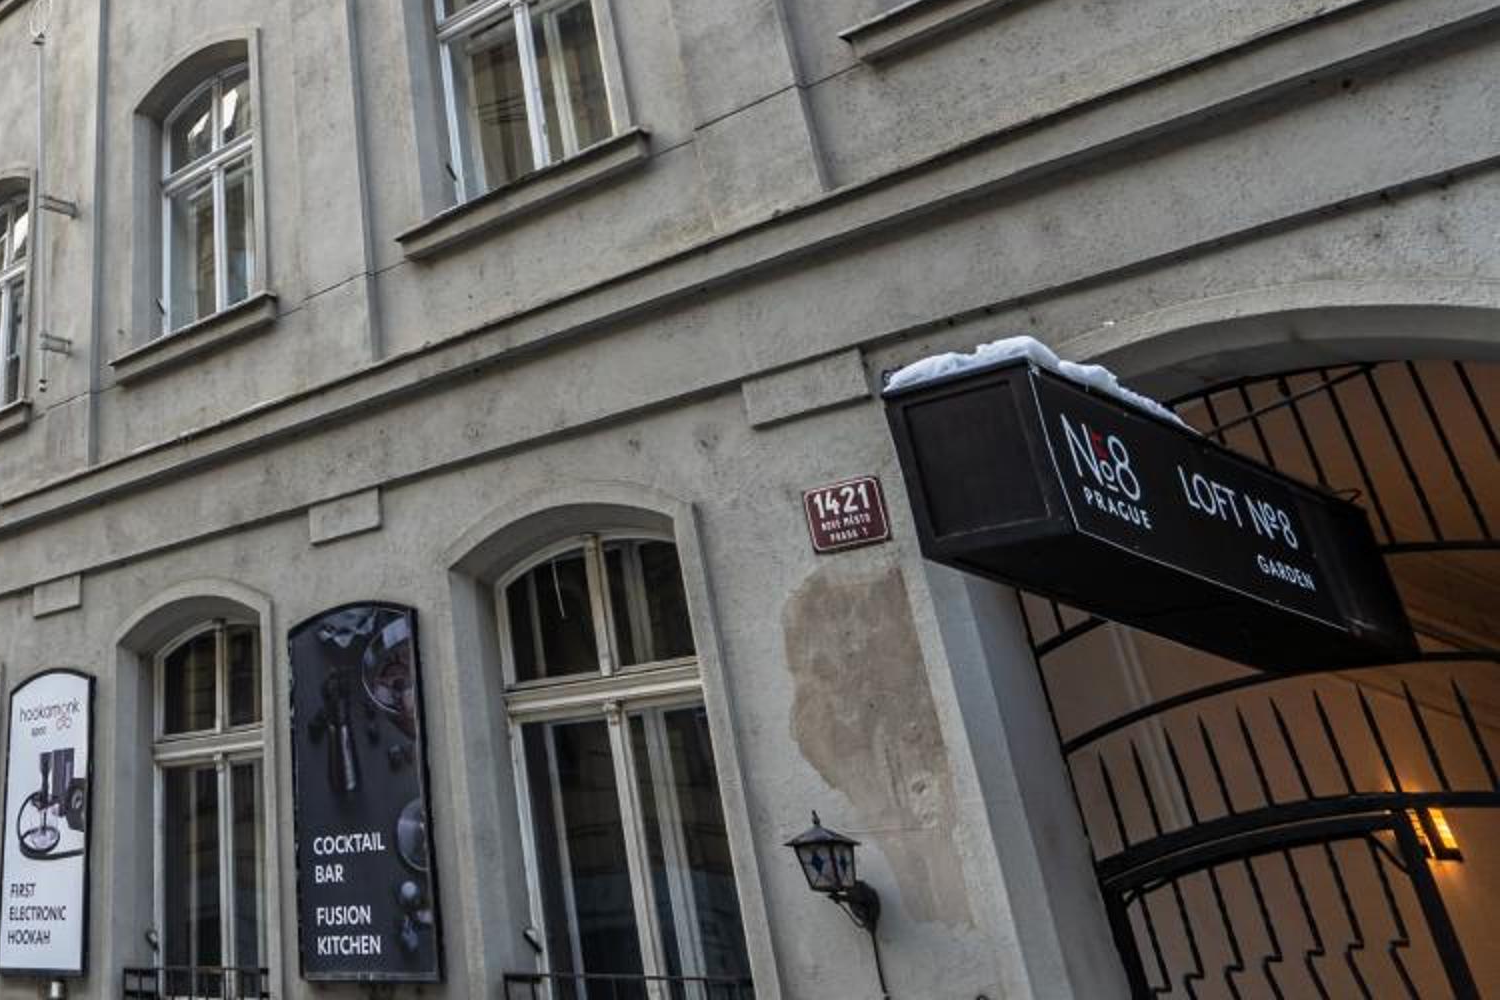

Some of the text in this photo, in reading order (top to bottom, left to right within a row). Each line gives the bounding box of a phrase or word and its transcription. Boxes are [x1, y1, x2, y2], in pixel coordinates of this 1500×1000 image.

[813, 483, 870, 519] 1421
[1176, 464, 1243, 528] LOFT
[1083, 485, 1153, 531] PRAGUE
[1256, 553, 1317, 592] GARDEN
[312, 832, 386, 856] COCKTAIL
[314, 863, 345, 884] BAR
[10, 882, 37, 899] FIRST
[8, 904, 67, 921] ELECTRONIC
[316, 904, 372, 927] FUSION
[7, 928, 52, 945] HOOKAH
[317, 935, 382, 956] KITCHEN
